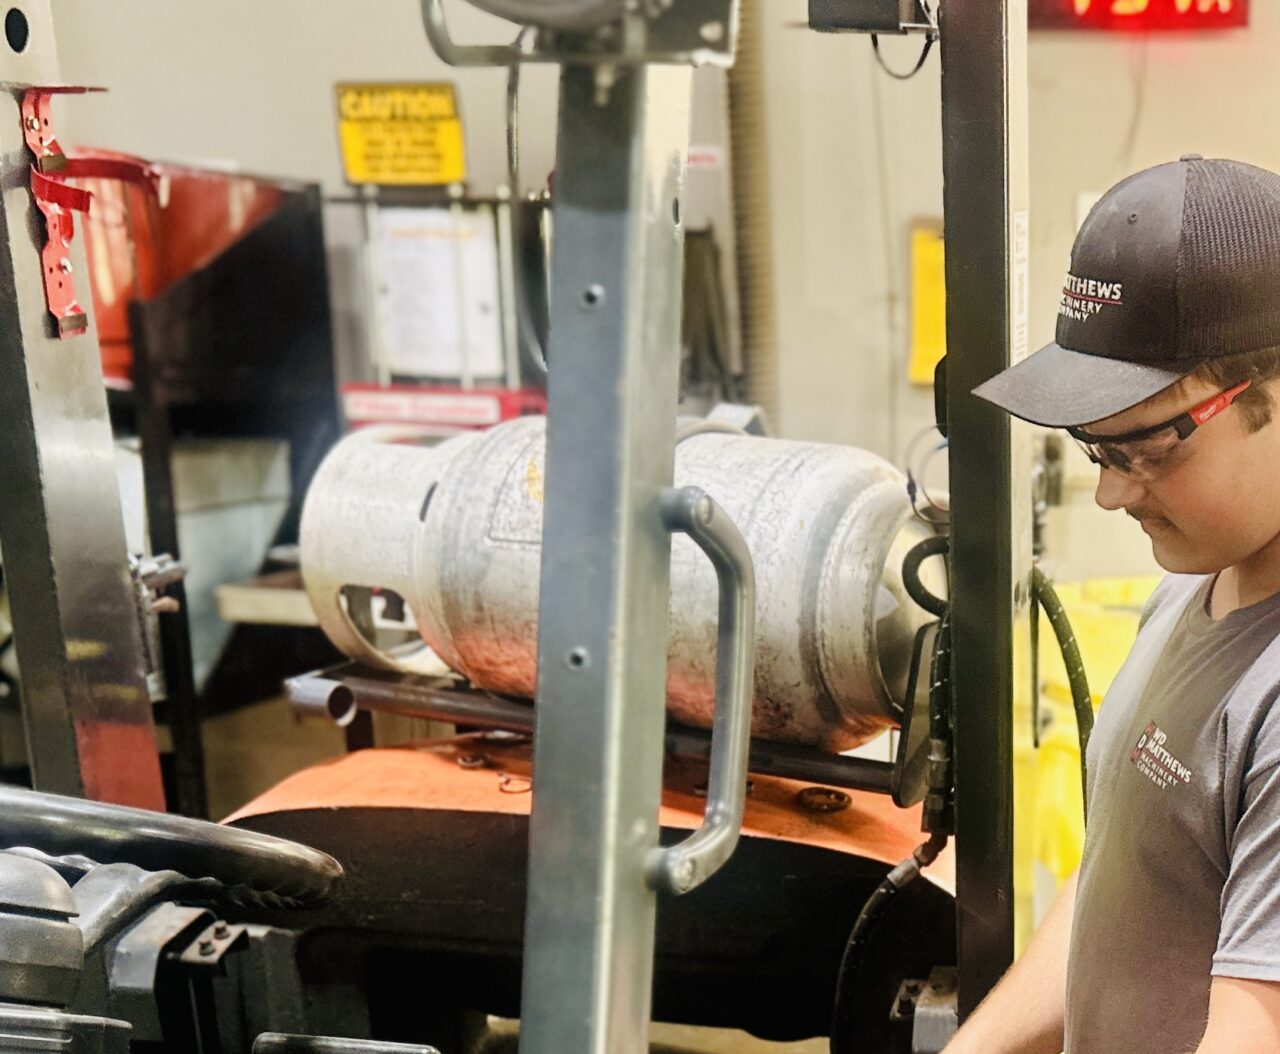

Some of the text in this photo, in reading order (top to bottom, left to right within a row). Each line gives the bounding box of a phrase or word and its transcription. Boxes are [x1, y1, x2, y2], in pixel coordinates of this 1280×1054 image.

[341, 90, 453, 119] CAUTION
[1066, 274, 1122, 300] TTHEWS
[1153, 727, 1167, 746] WD
[1140, 752, 1178, 787] MACHINERY
[1145, 738, 1192, 783] MATTHEWS
[1136, 761, 1168, 789] COMPANY
